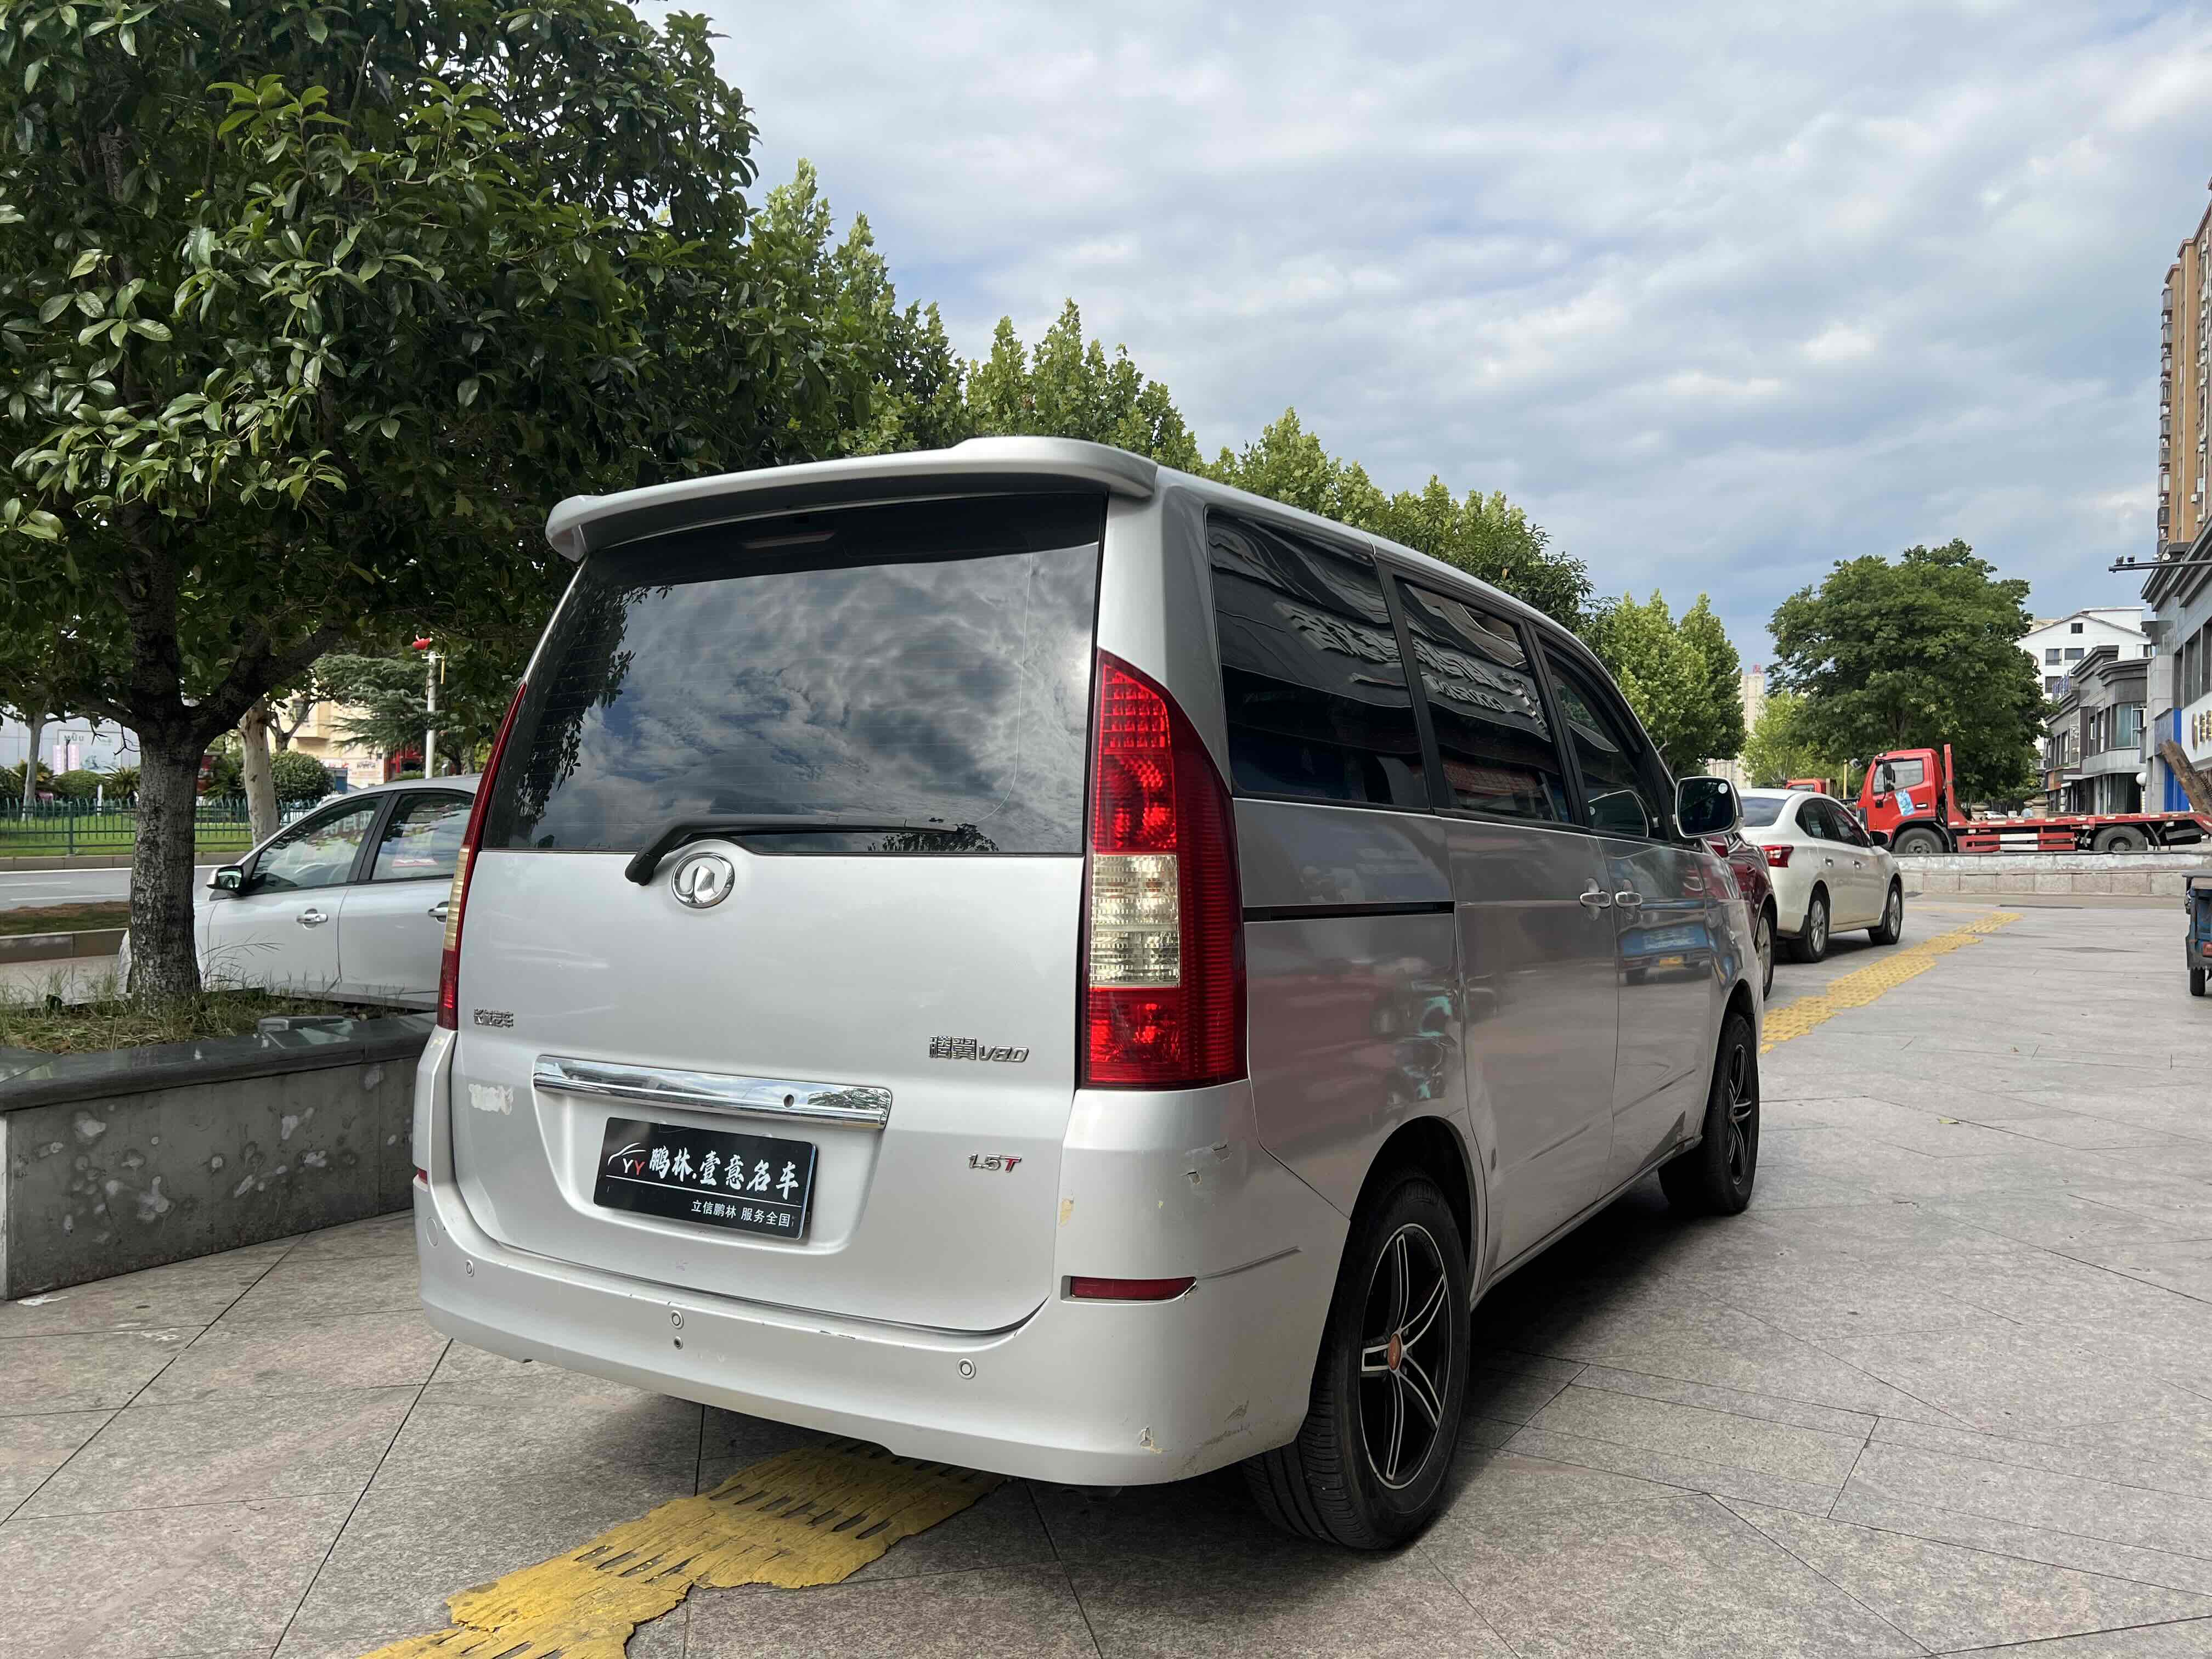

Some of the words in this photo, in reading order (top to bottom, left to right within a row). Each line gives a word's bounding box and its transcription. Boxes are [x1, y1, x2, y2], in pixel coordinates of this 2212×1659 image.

[979, 1045, 1029, 1063] V80
[623, 1158, 646, 1175] YY
[967, 1154, 1022, 1172] 1.5T
[691, 1200, 736, 1219] 立信鹏林
[741, 1207, 791, 1227] 服务全国
